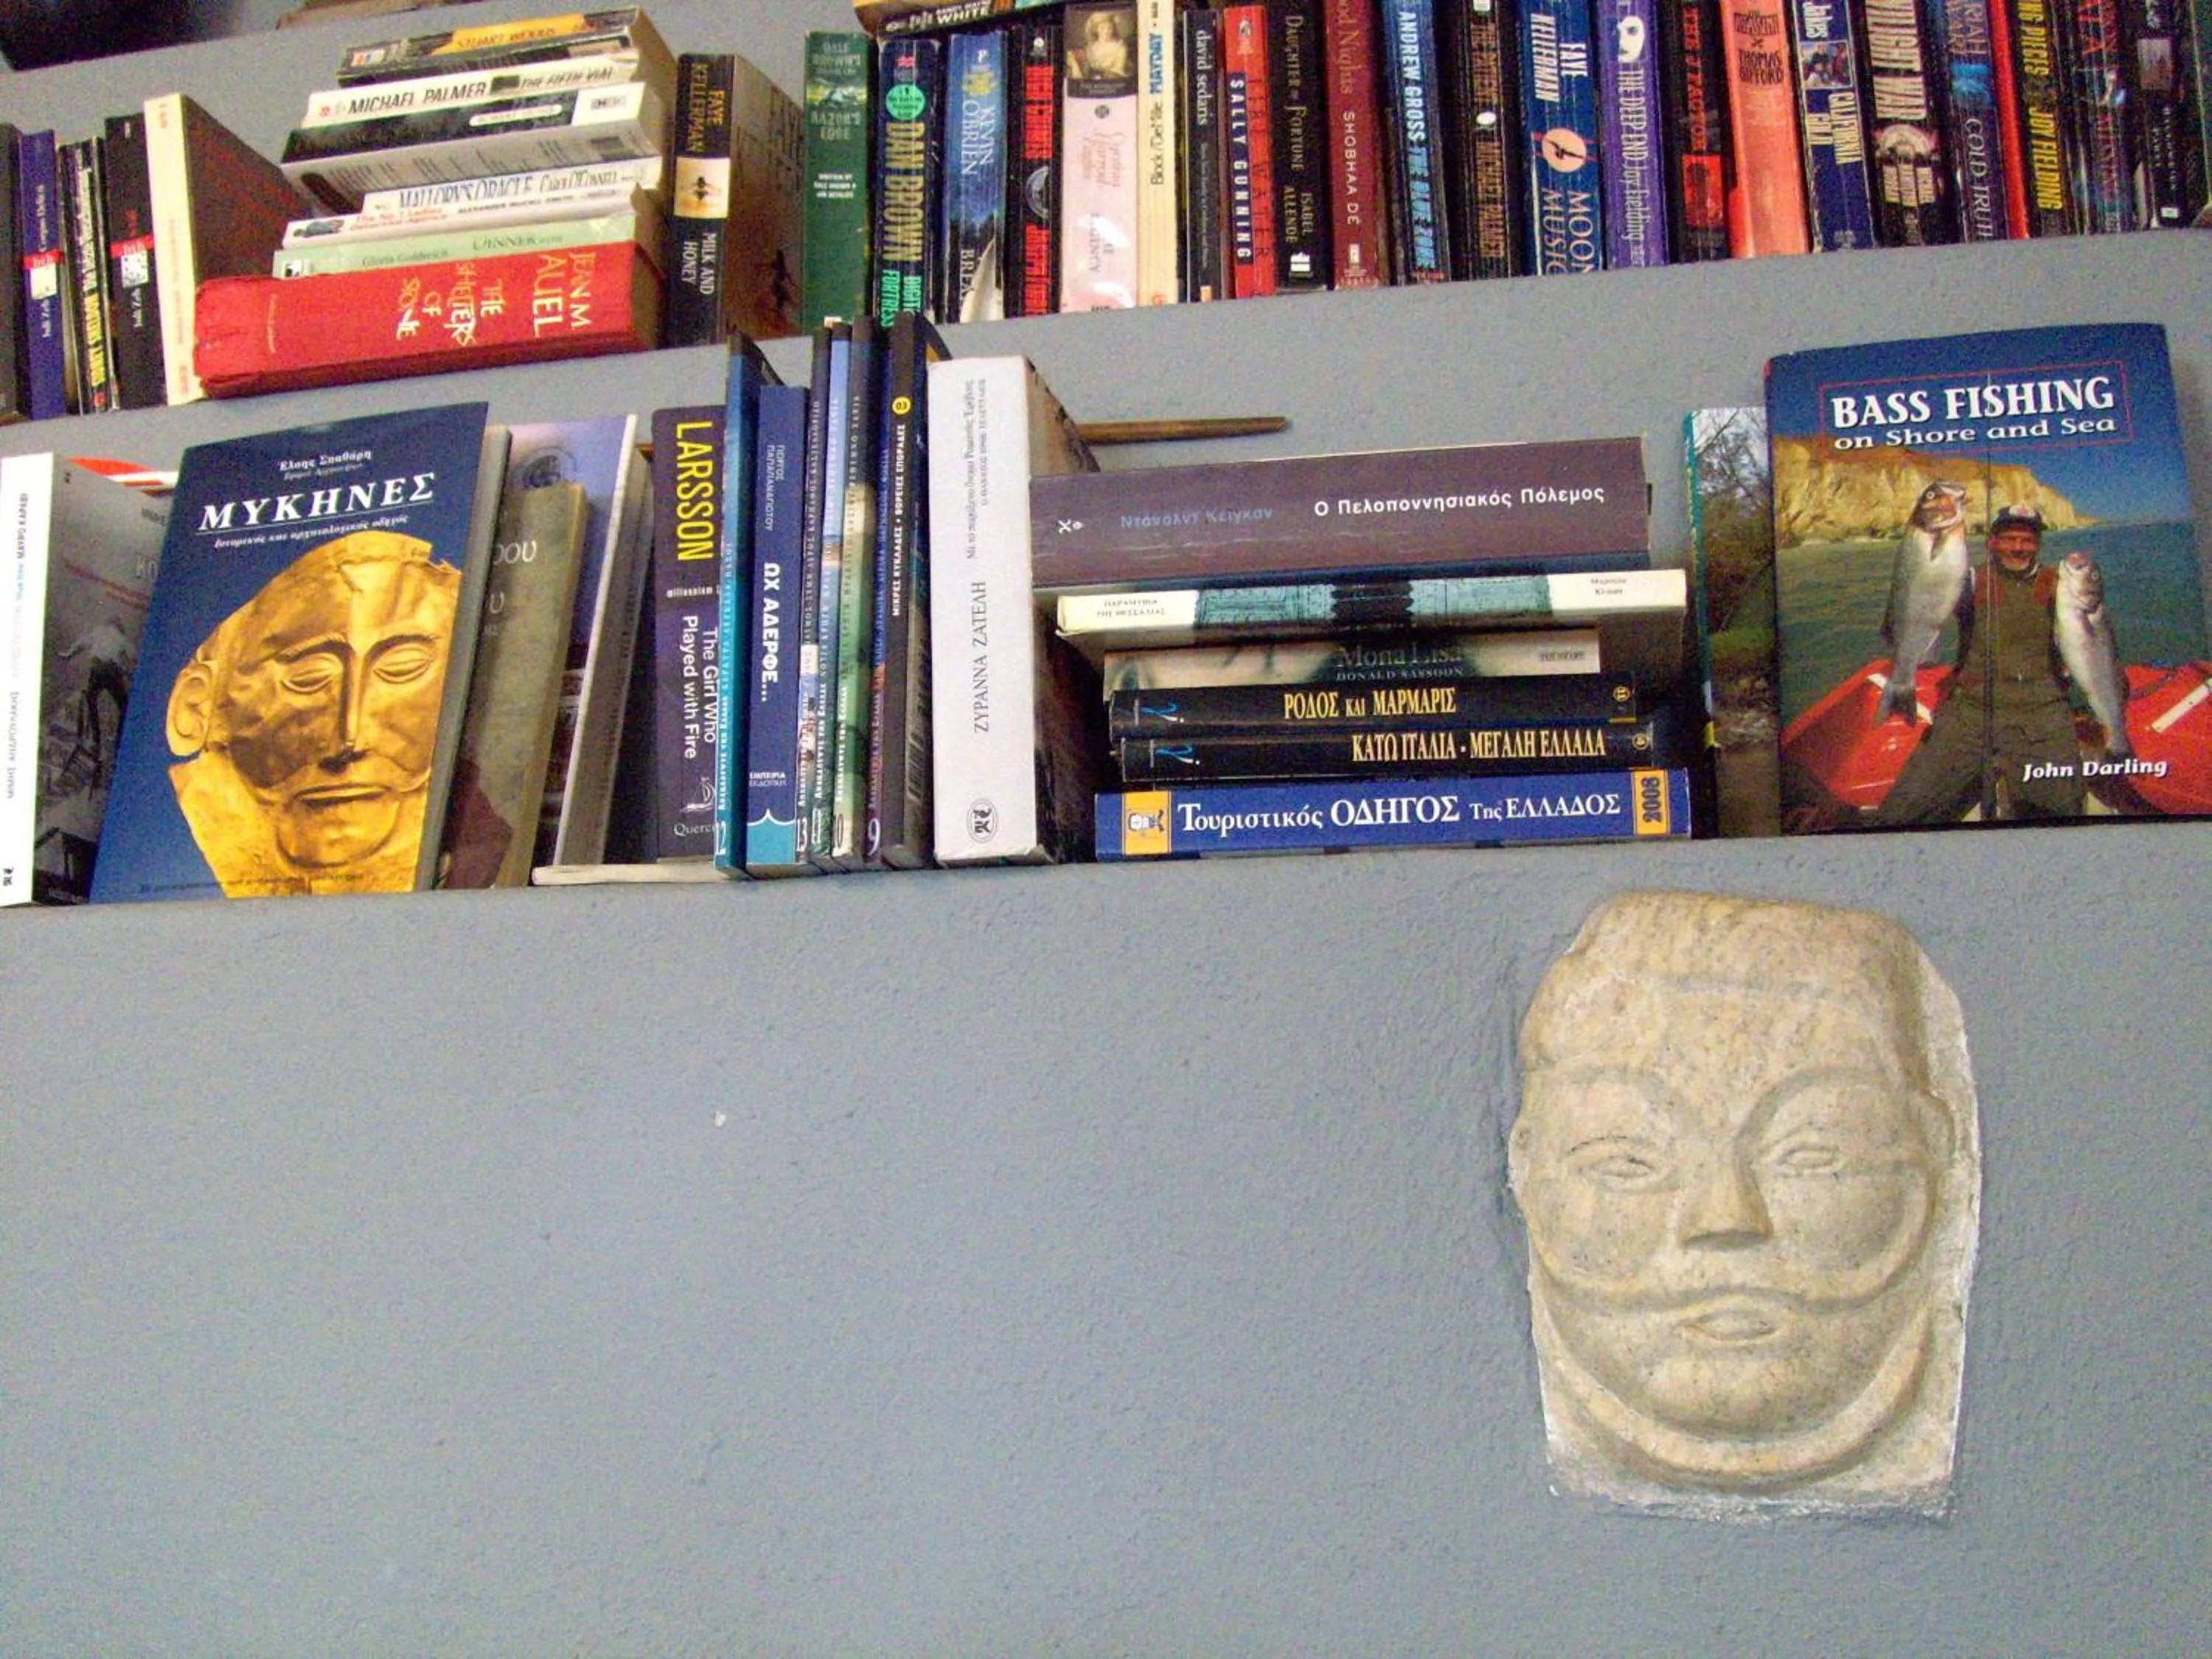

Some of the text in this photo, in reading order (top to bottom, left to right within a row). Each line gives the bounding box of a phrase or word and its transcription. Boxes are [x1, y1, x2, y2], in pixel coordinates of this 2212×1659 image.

[938, 5, 990, 24] WHITE
[1802, 2, 1833, 39] Jakes
[1148, 32, 1164, 94] MAYDAY
[1196, 30, 1213, 71] david
[1333, 32, 1361, 95] Nights
[1399, 11, 1421, 80] ANDREW
[1531, 13, 1559, 102] KELLERMAN
[1559, 43, 1587, 77] FAYE
[1739, 47, 1782, 66] THOMAS
[348, 93, 415, 113] MICHAEL
[423, 82, 487, 103] PALMER
[586, 66, 614, 81] VIAL
[1196, 74, 1214, 126] sedaris
[1283, 15, 1308, 173] DAUGHTER FORTUNE
[1616, 68, 1646, 94] THE
[1873, 75, 1927, 120] WAR
[686, 63, 708, 153] KELLERMAN
[707, 90, 726, 126] FAYE
[1405, 86, 1427, 142] GROSS
[1618, 97, 1647, 130] DEEP
[1805, 112, 1834, 146] GOLD
[1828, 91, 1863, 165] CALIFORNIA
[2020, 26, 2063, 210] PIECES JOY FIELDING
[885, 122, 925, 170] DAN
[961, 100, 978, 175] O'BRIEN
[979, 105, 995, 166] KEVIN
[1342, 111, 1358, 197] SHOBHAA
[1620, 133, 1649, 160] END
[1964, 118, 1989, 178] COLD
[1229, 80, 1252, 258] SALLY GUNNING
[1408, 147, 1429, 178] THE
[475, 174, 533, 202] ORACLE
[1410, 181, 1432, 223] BLUE
[883, 175, 925, 262] BROWN
[1283, 186, 1298, 243] ALLENDE
[1300, 192, 1315, 237] ISABEL
[1478, 204, 1505, 258] PALMER
[1541, 189, 1568, 276] MUSIC
[681, 242, 698, 285] HONEY
[699, 233, 717, 295] MILK AND
[1413, 224, 1436, 269] ZONE
[421, 291, 442, 316] OF
[480, 278, 507, 318] THE
[532, 254, 567, 337] AUEL
[570, 252, 596, 327] JEAN M
[902, 275, 921, 315] DIGIT
[1831, 376, 2115, 428] BASS FISHING
[1833, 416, 2117, 451] on Shore and Sea
[198, 472, 436, 531] ΜΥΚΗΝΕΣ
[675, 421, 714, 561] LARSSON
[1314, 484, 1605, 517] Ο Πελοποννησιακός Πόλεμος
[891, 424, 905, 616] ΜΙΚΡΕΣ ΚΥΚΛΑΔΕΣ ΒΟΡΕΙΕΣ ΣΠΟΡΑΔΕΣ
[763, 563, 781, 591] ΩΧ
[970, 582, 990, 734] ΖΥΡΑΝΝΑ ΖΑΤΕΛΗ
[1336, 667, 1464, 681] DONALD SASSOON
[1337, 642, 1464, 667] Mona Lisa
[680, 615, 700, 759] Played with Fire
[702, 627, 720, 743] The Girl Who
[1284, 691, 1339, 720] ΡΟΔΟΣ
[1372, 686, 1457, 716] ΜΑΡΜΑΡΙΣ
[1352, 727, 1607, 762] ΚΑΤΩ ΙΤΑΛΙΑ ΜΕΓΑΛΗ ΕΛΛΑΔΑ
[2023, 759, 2168, 782] John Darling
[1178, 793, 1621, 838] Τουριστικός ΟΔΗΓΟΣ Της ΕΛΛΑΔΟΣ
[1641, 776, 1661, 824] 2008
[673, 822, 716, 837] Querc
[714, 821, 728, 855] 12
[867, 818, 880, 856] 9
